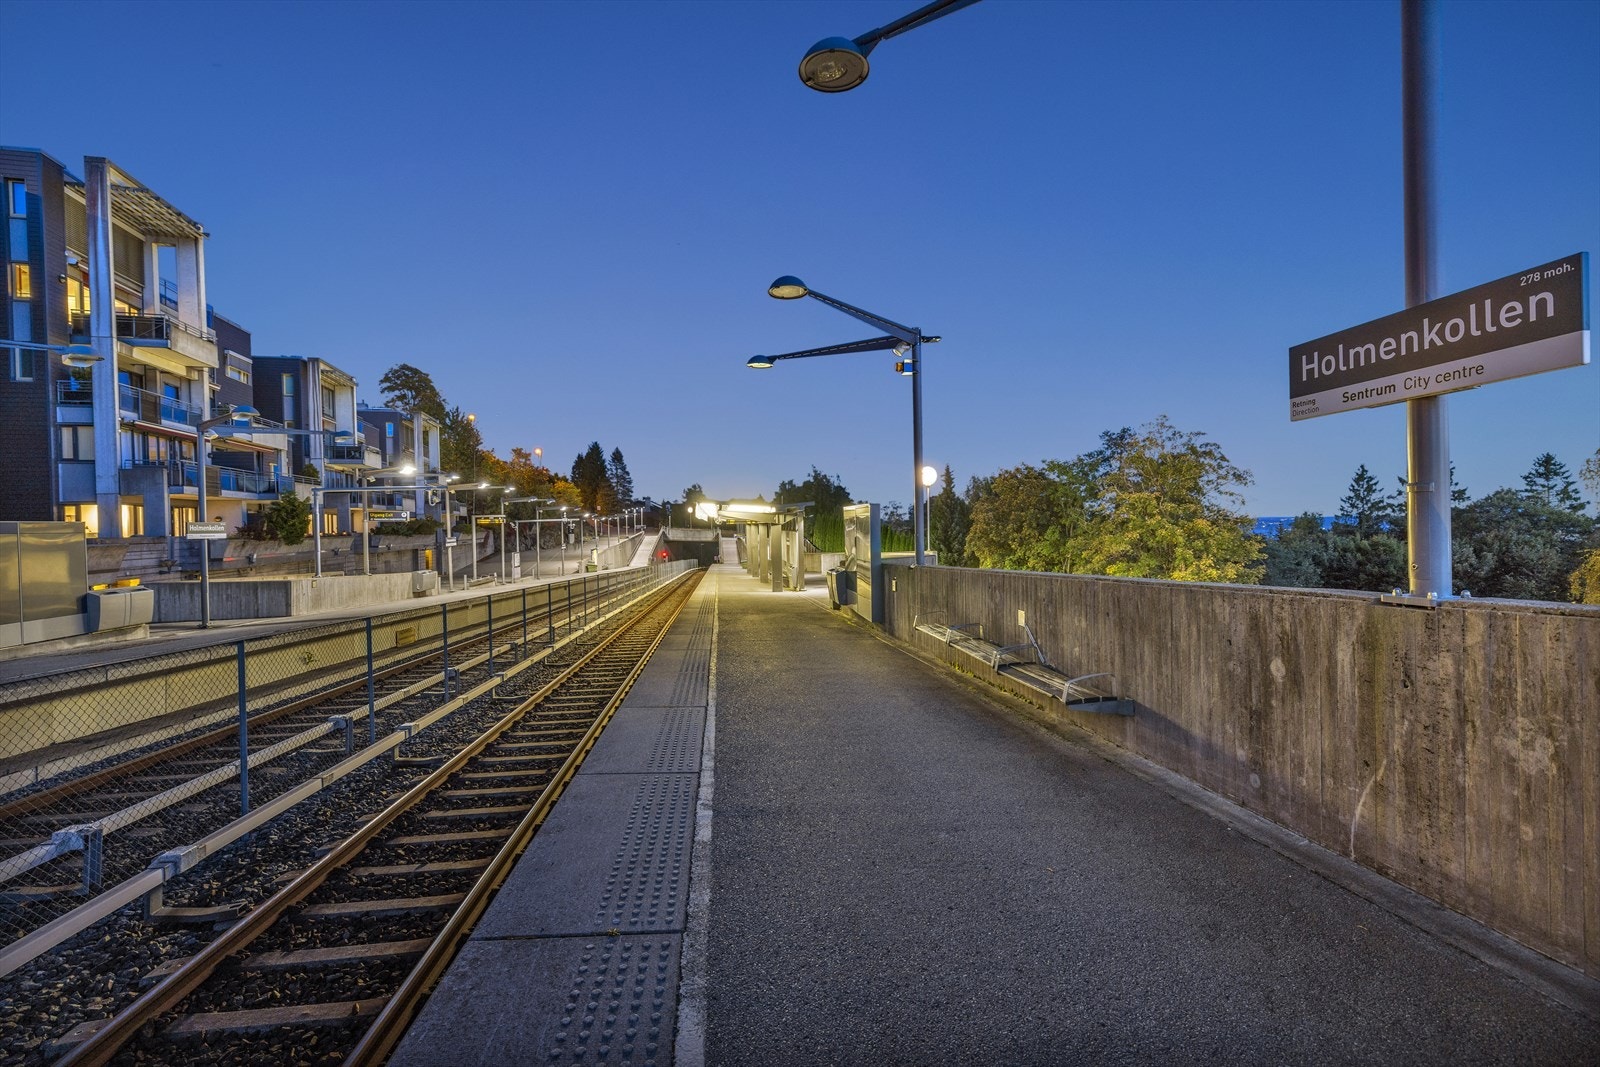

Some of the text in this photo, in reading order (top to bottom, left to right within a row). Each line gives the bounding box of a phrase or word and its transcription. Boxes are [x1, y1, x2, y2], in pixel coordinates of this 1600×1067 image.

[1520, 263, 1575, 287] 278 moh.
[1302, 291, 1555, 382] Holmenkollen
[1342, 364, 1485, 403] Sentrum City centre
[1292, 398, 1316, 409] Retning
[1292, 406, 1320, 417] Direction
